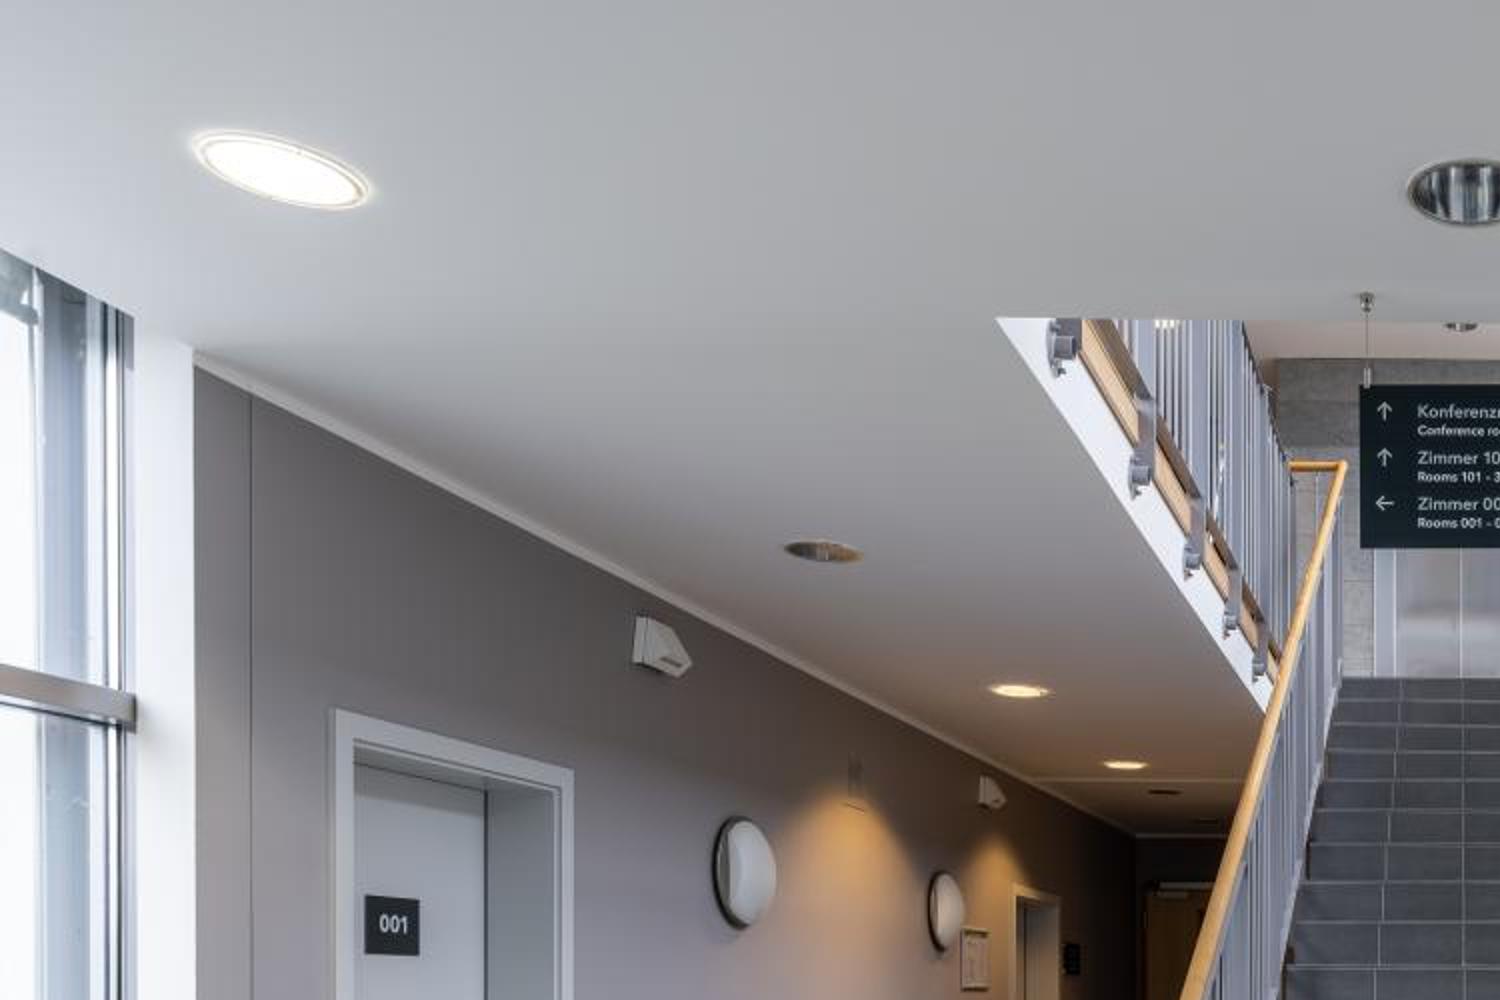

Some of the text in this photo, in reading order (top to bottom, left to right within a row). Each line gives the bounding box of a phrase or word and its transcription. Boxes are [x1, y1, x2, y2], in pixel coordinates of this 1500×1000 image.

[1418, 424, 1485, 436] Conference
[1418, 451, 1478, 464] Zimmer
[1418, 471, 1458, 482] Rooms
[1462, 471, 1480, 483] 101
[1418, 497, 1479, 510] Zimmer
[1418, 517, 1458, 528] Rooms
[1460, 517, 1482, 528] 001
[379, 914, 407, 934] 001
